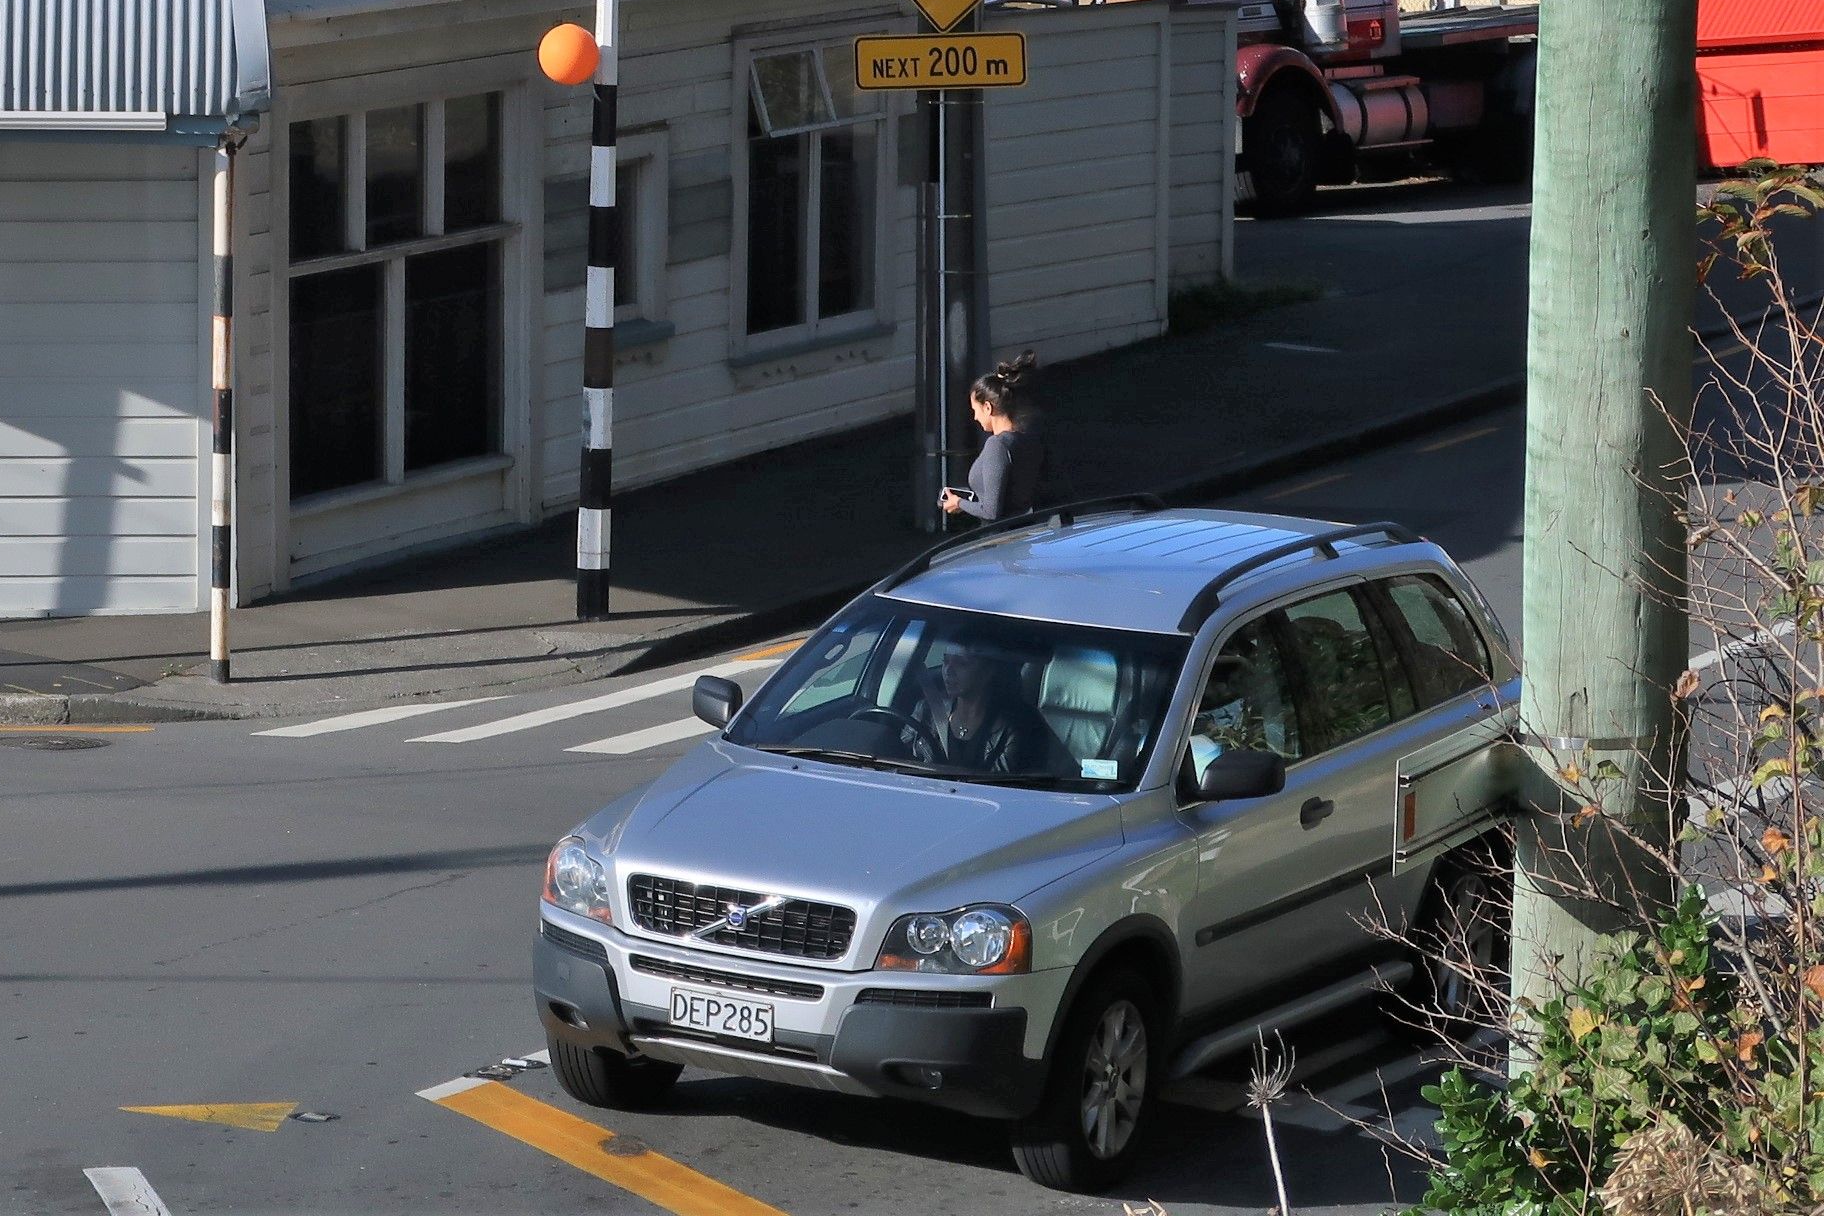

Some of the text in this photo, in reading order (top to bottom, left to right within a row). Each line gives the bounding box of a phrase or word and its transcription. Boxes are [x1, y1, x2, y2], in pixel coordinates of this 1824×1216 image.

[872, 45, 1009, 79] NEXT 200 m
[672, 993, 770, 1036] DEP285
